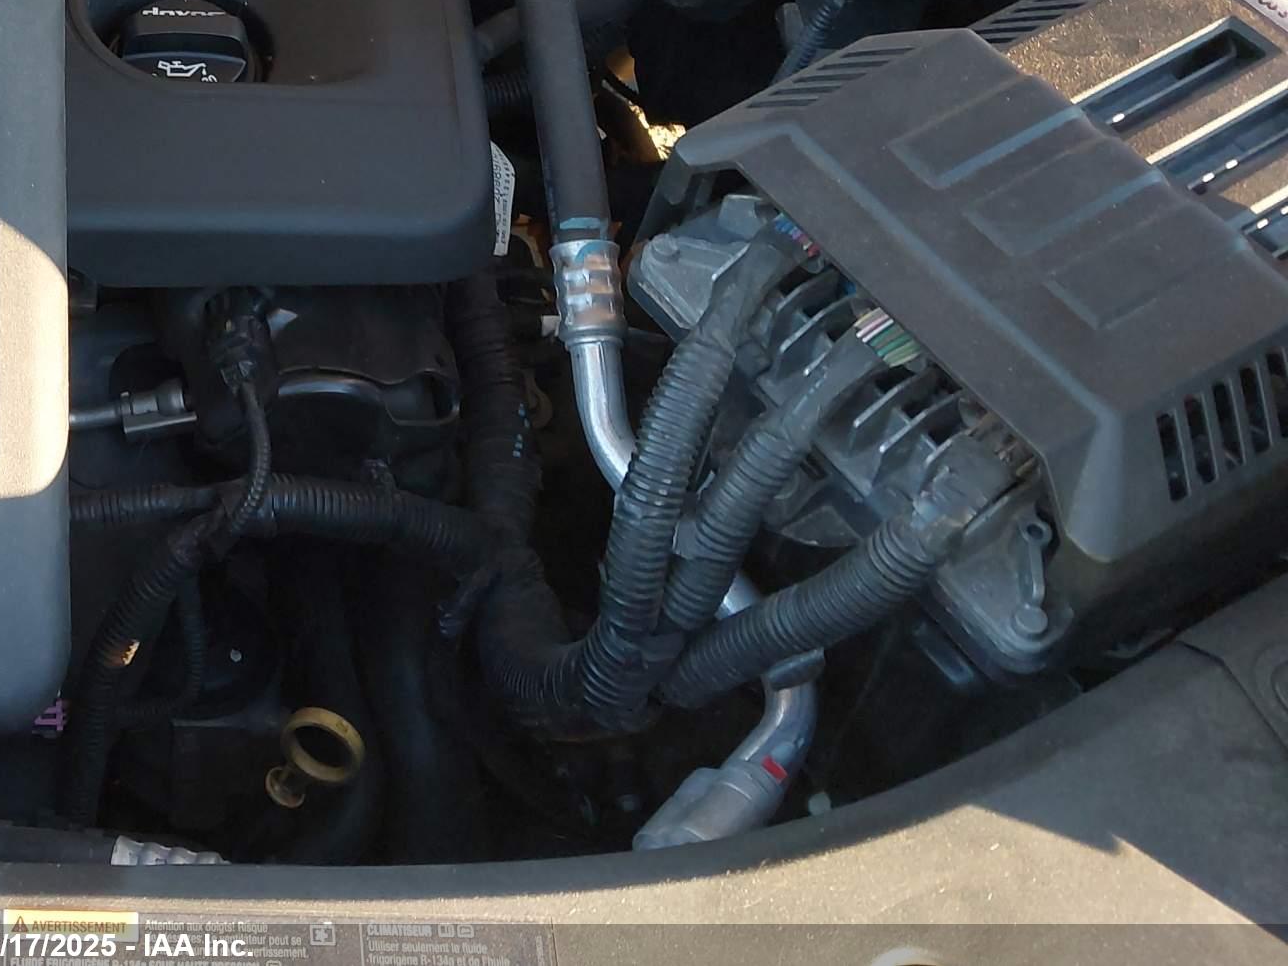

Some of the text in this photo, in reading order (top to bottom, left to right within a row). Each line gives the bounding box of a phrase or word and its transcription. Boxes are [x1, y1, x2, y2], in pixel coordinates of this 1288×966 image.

[32, 920, 127, 934] AVERTISSEMENT
[145, 920, 185, 932] Attention
[366, 924, 433, 937] CLIMATISEUR
[401, 942, 449, 953] seulement
